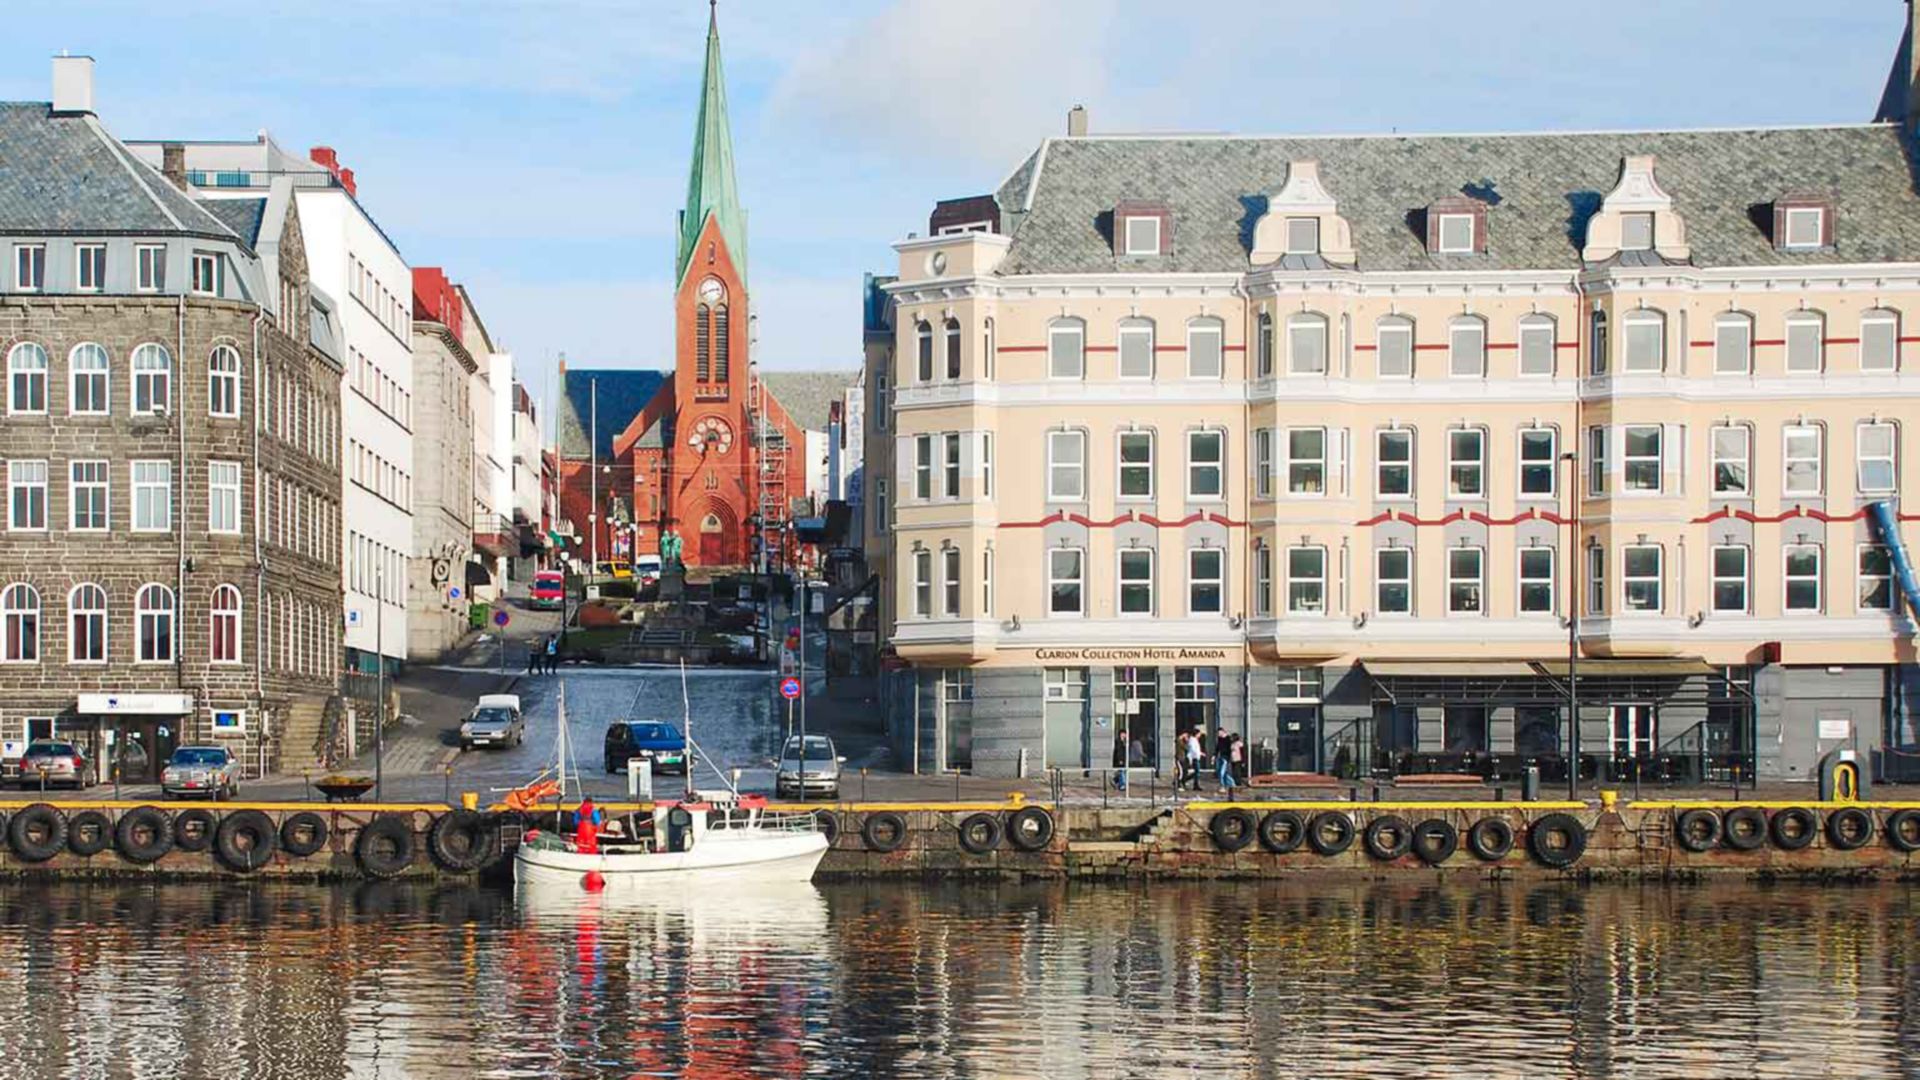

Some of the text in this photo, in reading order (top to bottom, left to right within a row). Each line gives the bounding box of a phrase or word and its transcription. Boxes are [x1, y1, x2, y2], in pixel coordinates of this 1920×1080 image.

[1035, 647, 1226, 660] CLARION COLLECTION HOTEL AMANDA
